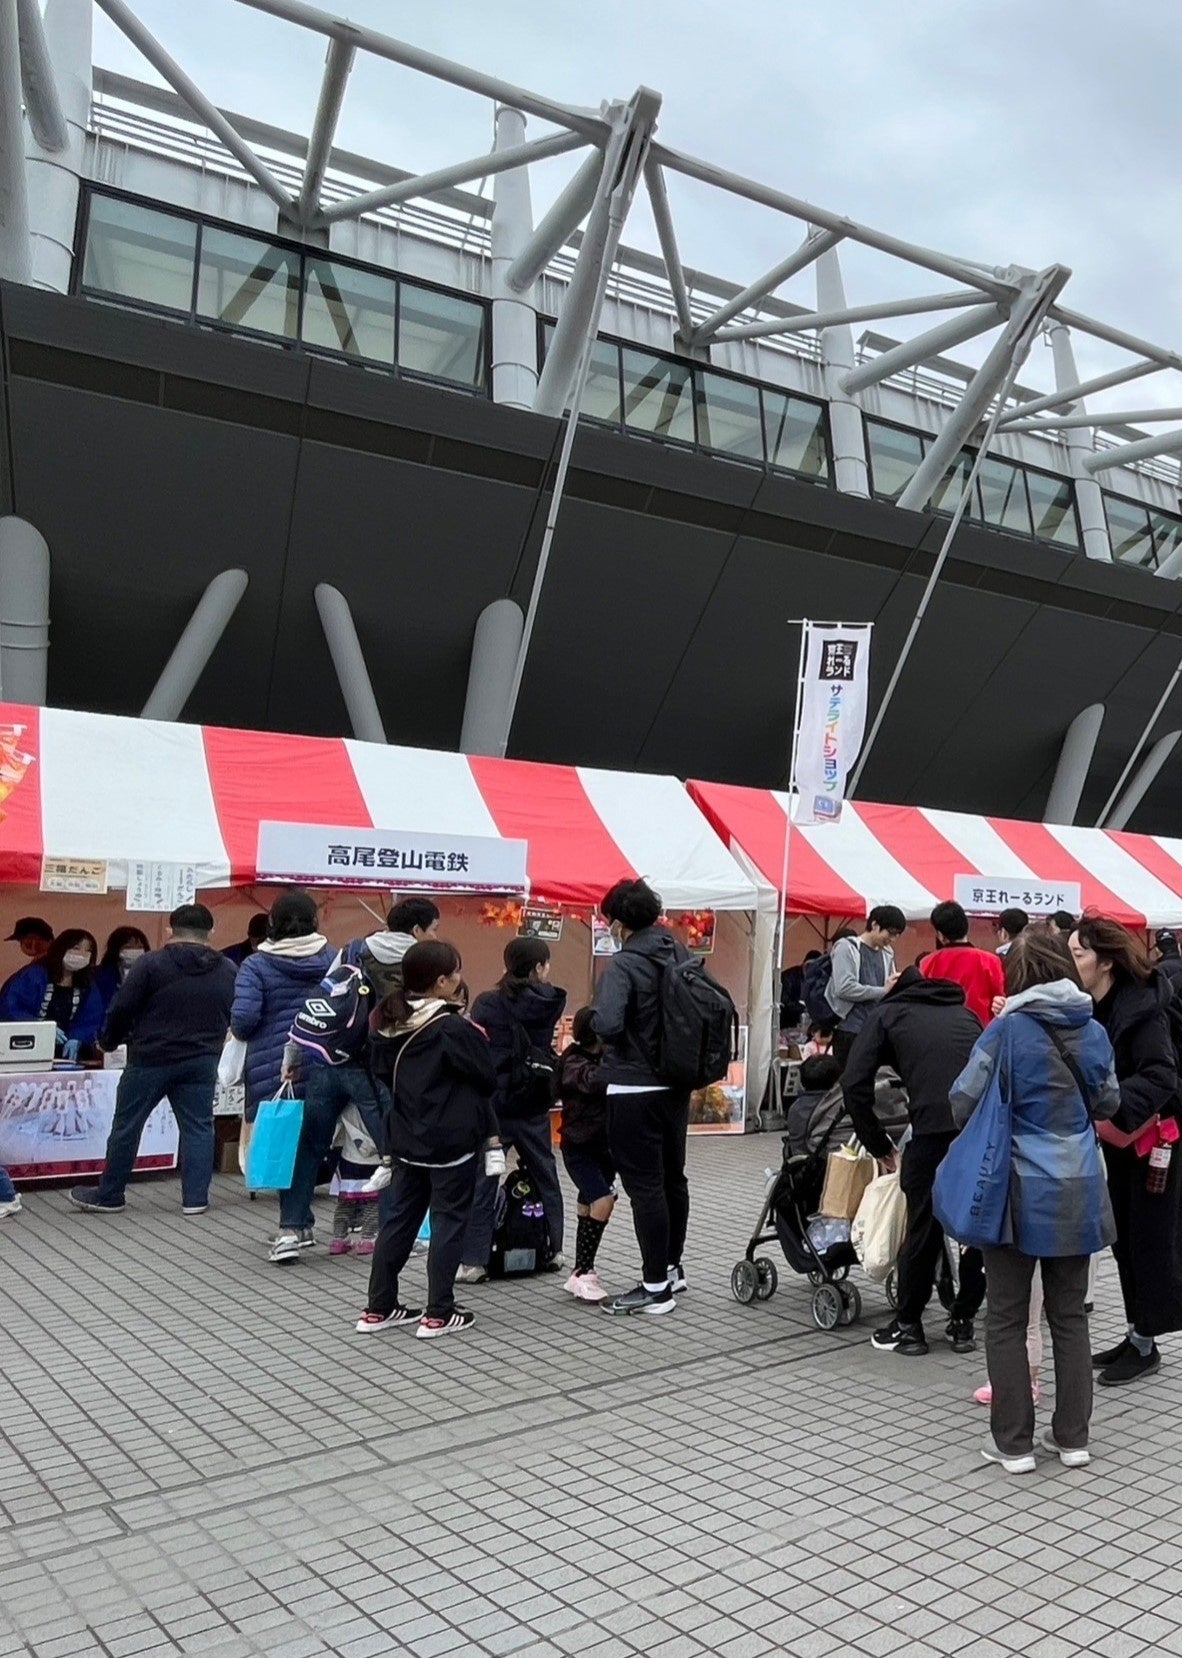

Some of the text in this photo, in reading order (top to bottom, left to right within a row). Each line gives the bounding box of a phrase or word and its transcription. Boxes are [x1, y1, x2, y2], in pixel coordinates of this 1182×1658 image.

[823, 684, 843, 792] サテライトショップ
[327, 844, 469, 872] 高尾登山電鉄
[972, 888, 1065, 906] 京王れーるランド
[298, 1011, 327, 1029] umbro
[969, 1140, 997, 1217] BEAUTY
